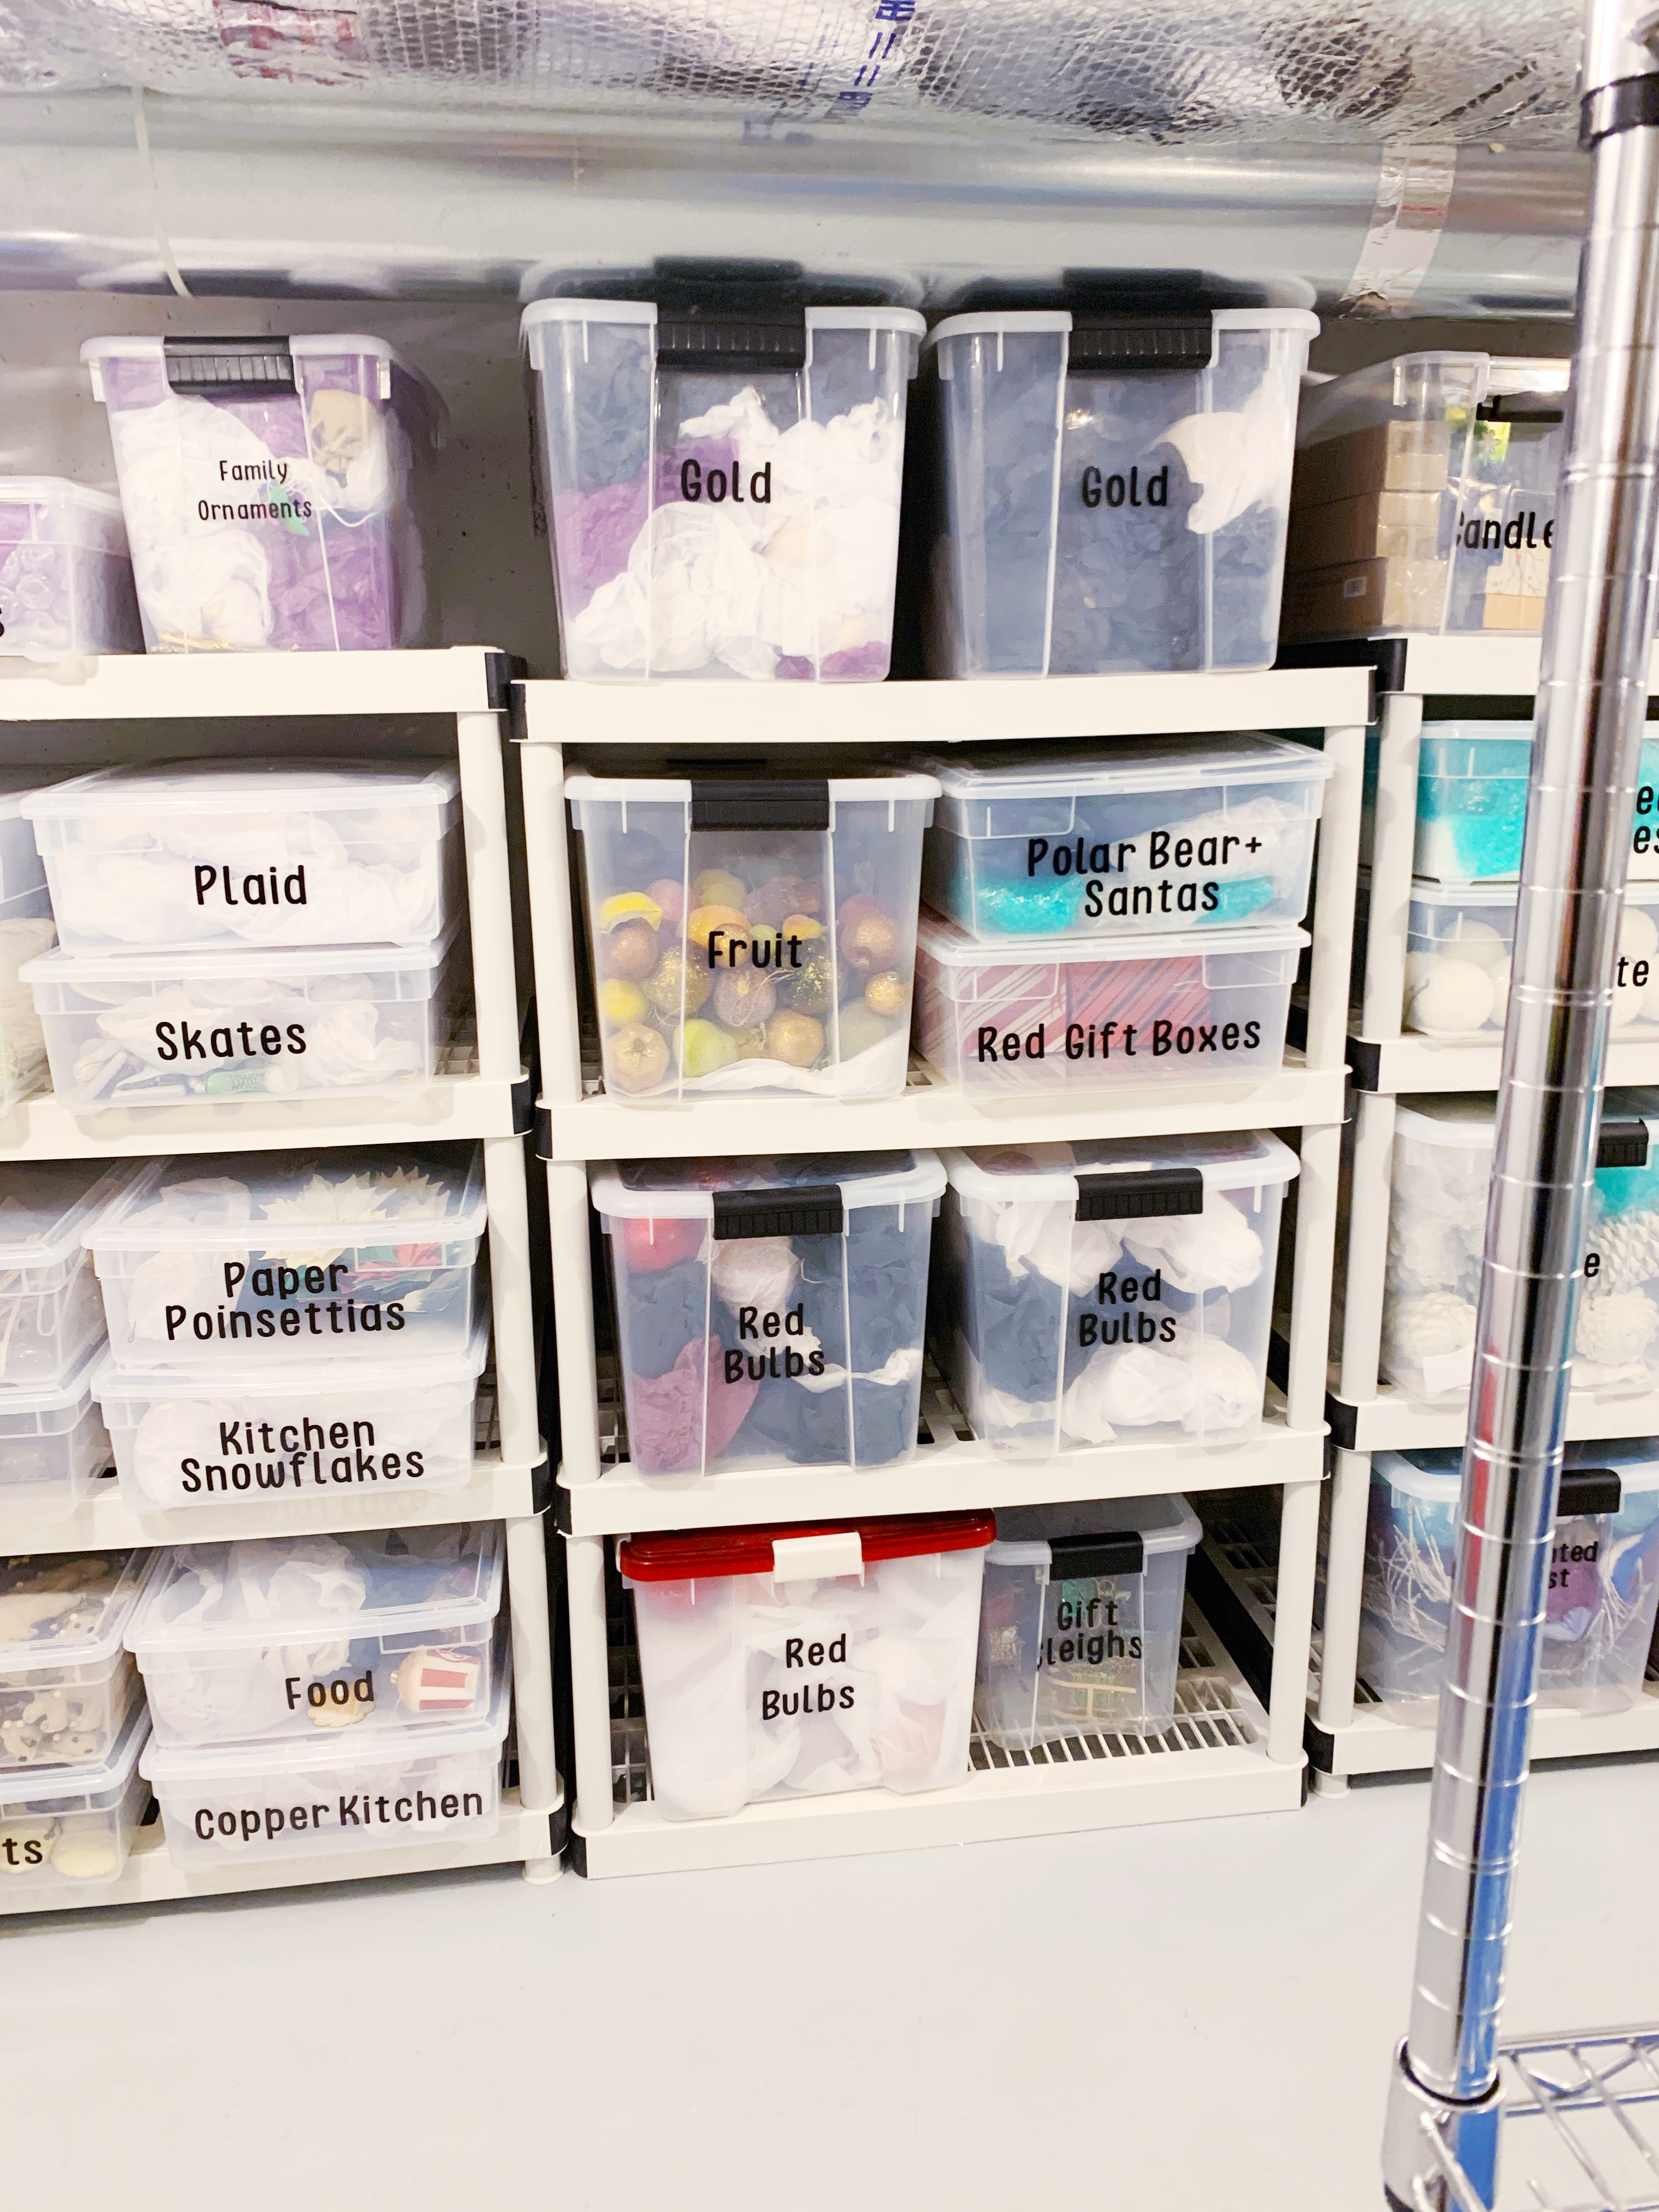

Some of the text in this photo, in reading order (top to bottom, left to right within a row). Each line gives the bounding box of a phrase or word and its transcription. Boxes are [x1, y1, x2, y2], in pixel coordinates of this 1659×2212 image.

[219, 460, 289, 484] Family
[681, 459, 772, 504] Gold
[1081, 465, 1169, 508] Gold
[198, 500, 312, 521] Ornaments
[1028, 831, 1262, 877] Polar Bear+
[194, 865, 307, 905] Plaid
[1085, 879, 1220, 917] Santas
[708, 930, 803, 969] Fruit
[157, 1020, 307, 1061] Skates
[978, 1020, 1261, 1063] Red Gift Boxes
[224, 1261, 348, 1300] Paper
[1098, 1268, 1161, 1305] Red
[166, 1301, 405, 1340] Poinsettias
[739, 1302, 804, 1340] Red
[1079, 1311, 1177, 1347] Bulbs
[724, 1346, 825, 1384] Bulbs
[219, 1417, 375, 1455] Kitchen
[180, 1449, 425, 1492] Snowflakes
[1057, 1598, 1118, 1630] Gift
[786, 1633, 847, 1669] Red
[285, 1670, 375, 1710] Food
[762, 1683, 855, 1720] Bulbs
[195, 1791, 483, 1841] Copper Kitchen
